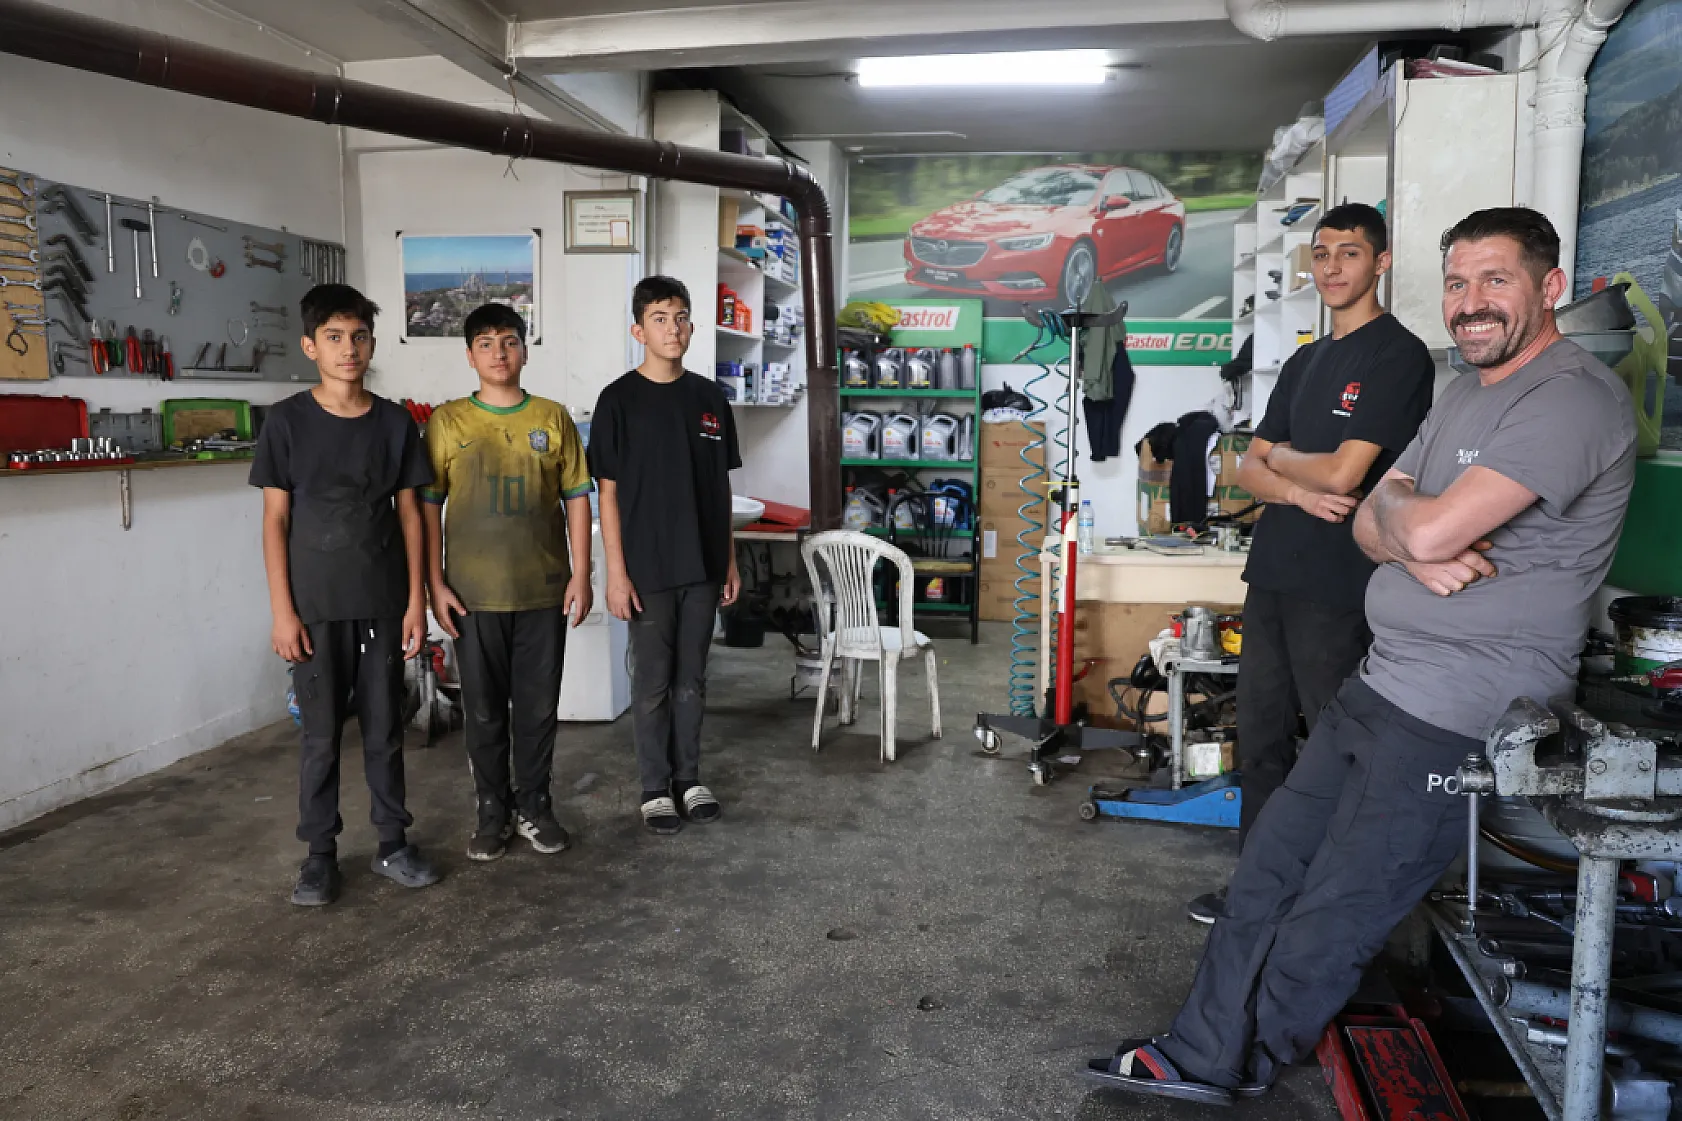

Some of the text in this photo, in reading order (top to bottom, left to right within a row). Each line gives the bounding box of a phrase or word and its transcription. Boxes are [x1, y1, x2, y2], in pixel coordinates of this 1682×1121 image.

[1124, 333, 1232, 351] Castrol EDG
[487, 475, 525, 516] 10
[1426, 772, 1470, 796] PO
